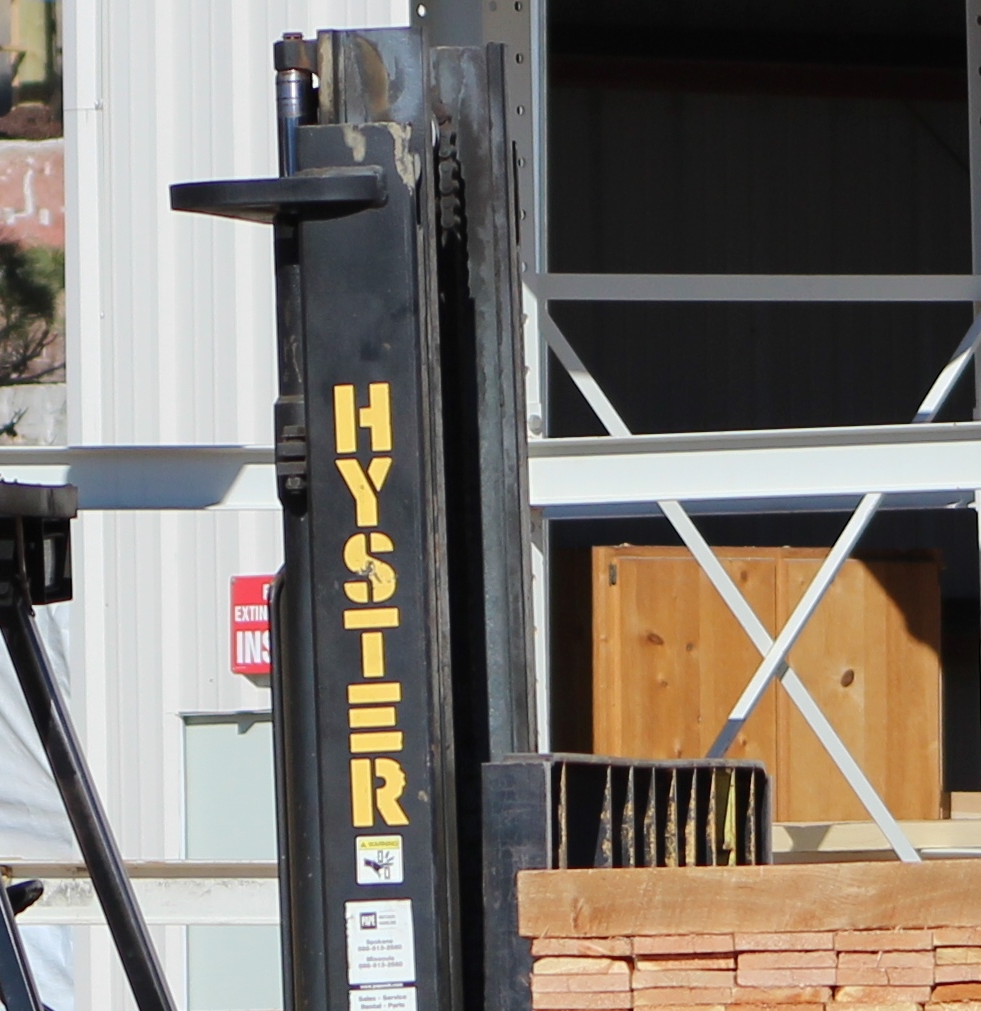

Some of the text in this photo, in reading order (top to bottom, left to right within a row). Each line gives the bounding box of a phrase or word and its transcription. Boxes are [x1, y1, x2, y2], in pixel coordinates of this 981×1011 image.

[234, 604, 269, 622] EXTIN
[333, 382, 409, 828] HYSTER
[236, 630, 271, 664] INS
